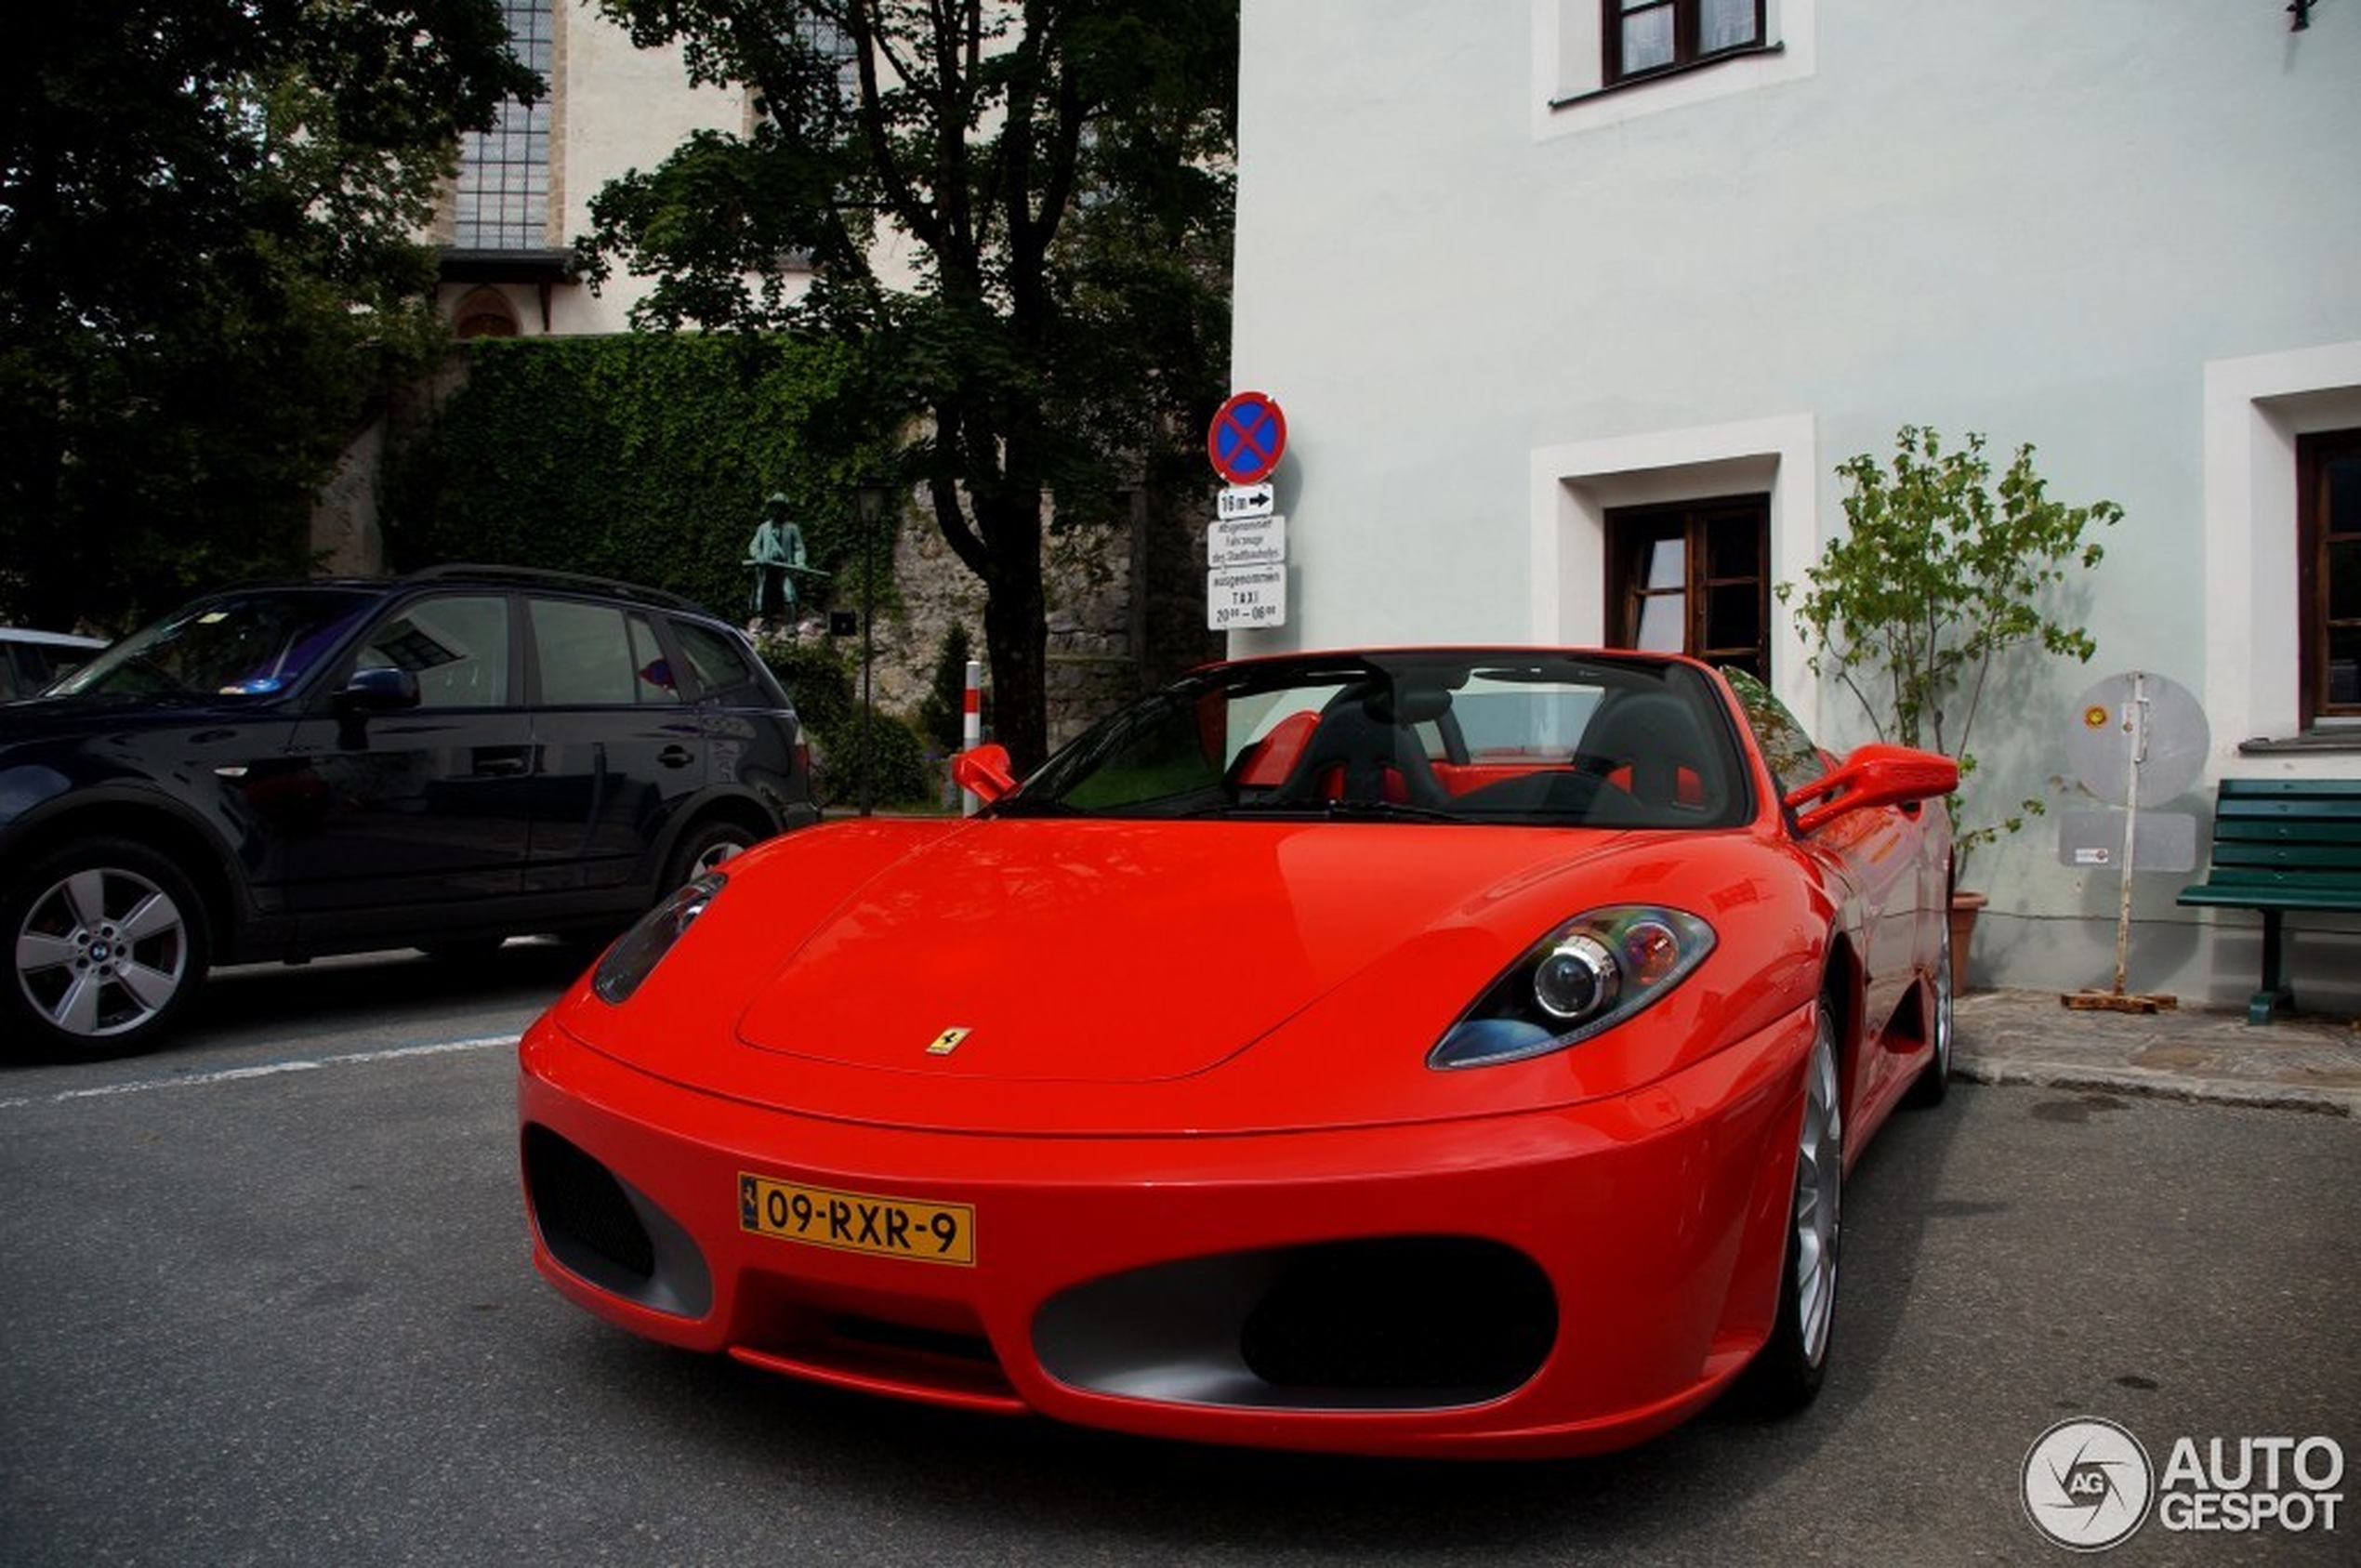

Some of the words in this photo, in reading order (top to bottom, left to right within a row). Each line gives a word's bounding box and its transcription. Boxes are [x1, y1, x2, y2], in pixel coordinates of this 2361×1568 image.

[1214, 573, 1280, 588] ausgenommen
[1233, 591, 1259, 605] TAXI
[767, 1190, 956, 1253] 09-RXR-9
